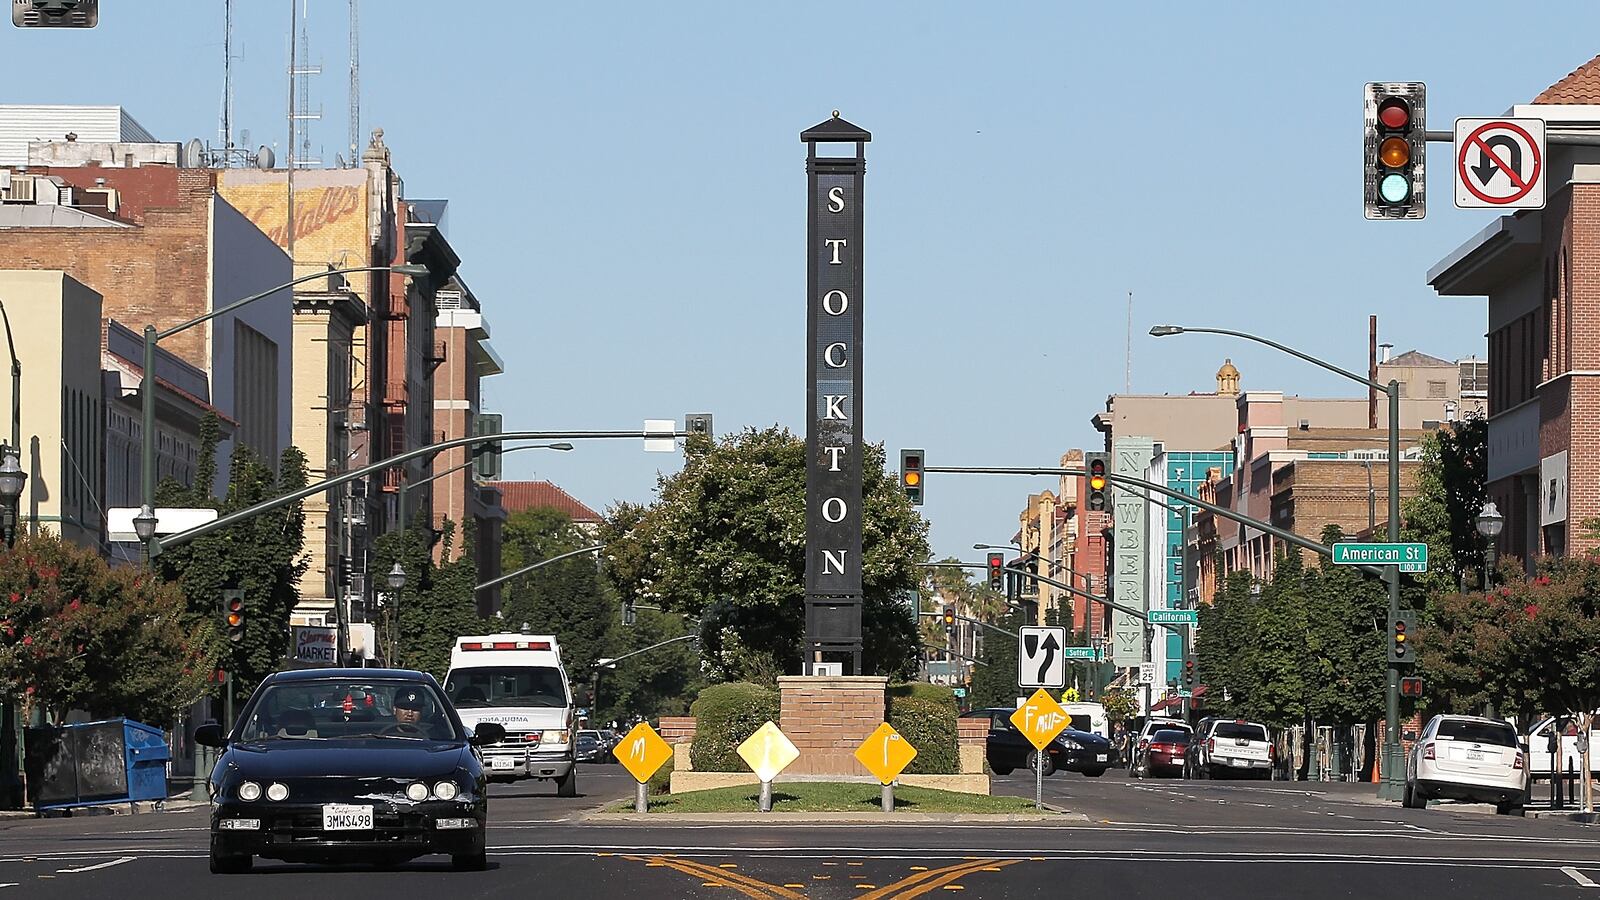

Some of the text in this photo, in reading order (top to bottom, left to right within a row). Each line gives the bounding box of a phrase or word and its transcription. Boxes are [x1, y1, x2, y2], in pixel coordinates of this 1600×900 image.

[822, 186, 849, 575] STOCKTON
[1341, 547, 1419, 560] American St
[1152, 612, 1192, 622] California
[297, 646, 337, 660] MARKET
[1069, 649, 1089, 657] Sutter
[1142, 673, 1154, 681] 25
[1025, 705, 1038, 732] F
[630, 736, 646, 762] M
